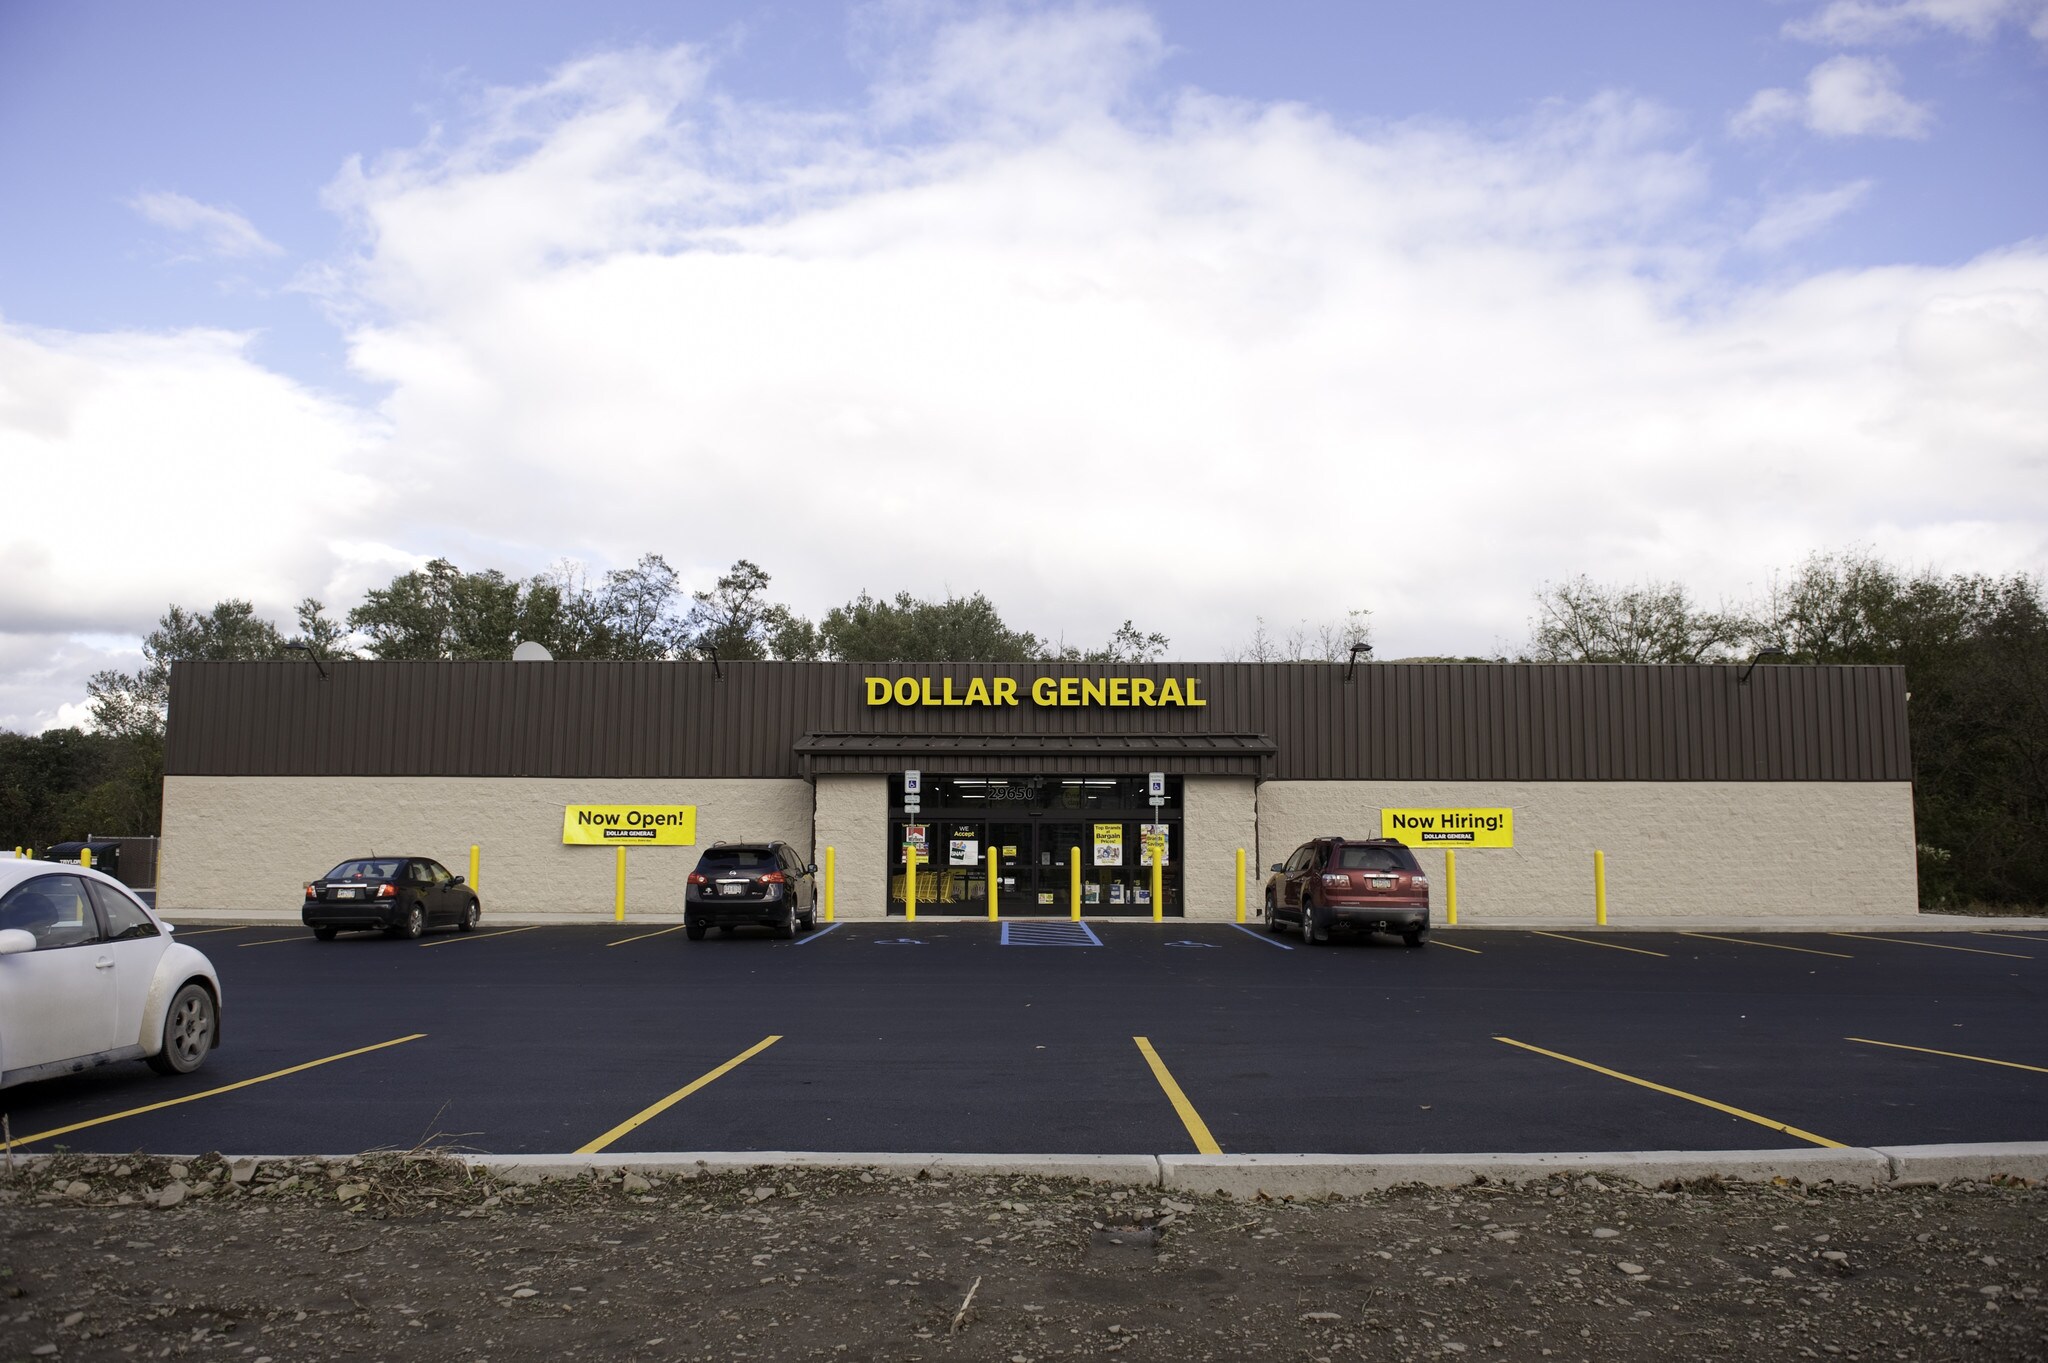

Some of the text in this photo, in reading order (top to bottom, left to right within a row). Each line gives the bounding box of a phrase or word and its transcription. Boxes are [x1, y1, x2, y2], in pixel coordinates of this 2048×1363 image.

[865, 677, 1206, 706] DOLLAR GENERAL
[988, 787, 1034, 800] 29650
[578, 811, 683, 828] Now Open!
[1393, 813, 1503, 831] Now Hiring!
